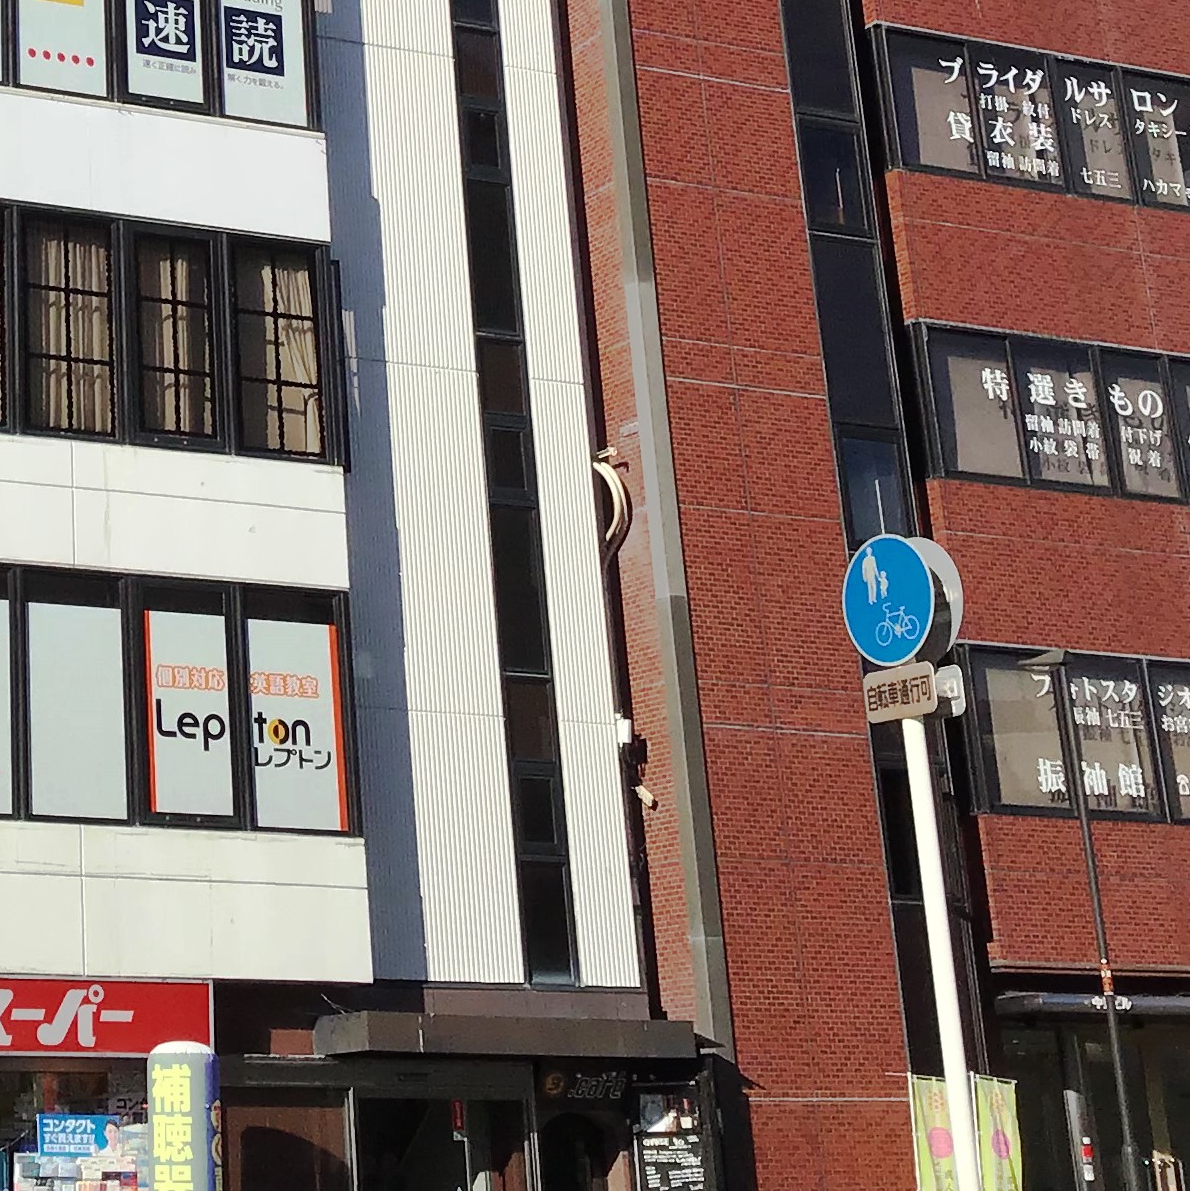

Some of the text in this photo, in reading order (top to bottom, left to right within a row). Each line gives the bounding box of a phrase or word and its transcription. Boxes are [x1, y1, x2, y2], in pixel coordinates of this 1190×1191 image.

[938, 56, 1178, 117] ブライダルサロン
[947, 110, 1056, 153] 貸衣装
[1070, 106, 1113, 129] ドレス
[1079, 166, 1122, 189] 七五三
[981, 367, 1164, 419] 特選きもの
[867, 673, 932, 712] 自転車通行可
[1107, 708, 1145, 730] 七五三
[253, 746, 332, 771] レプトン
[1036, 757, 1146, 798] 振袖館
[42, 1118, 96, 1134] コンタクト
